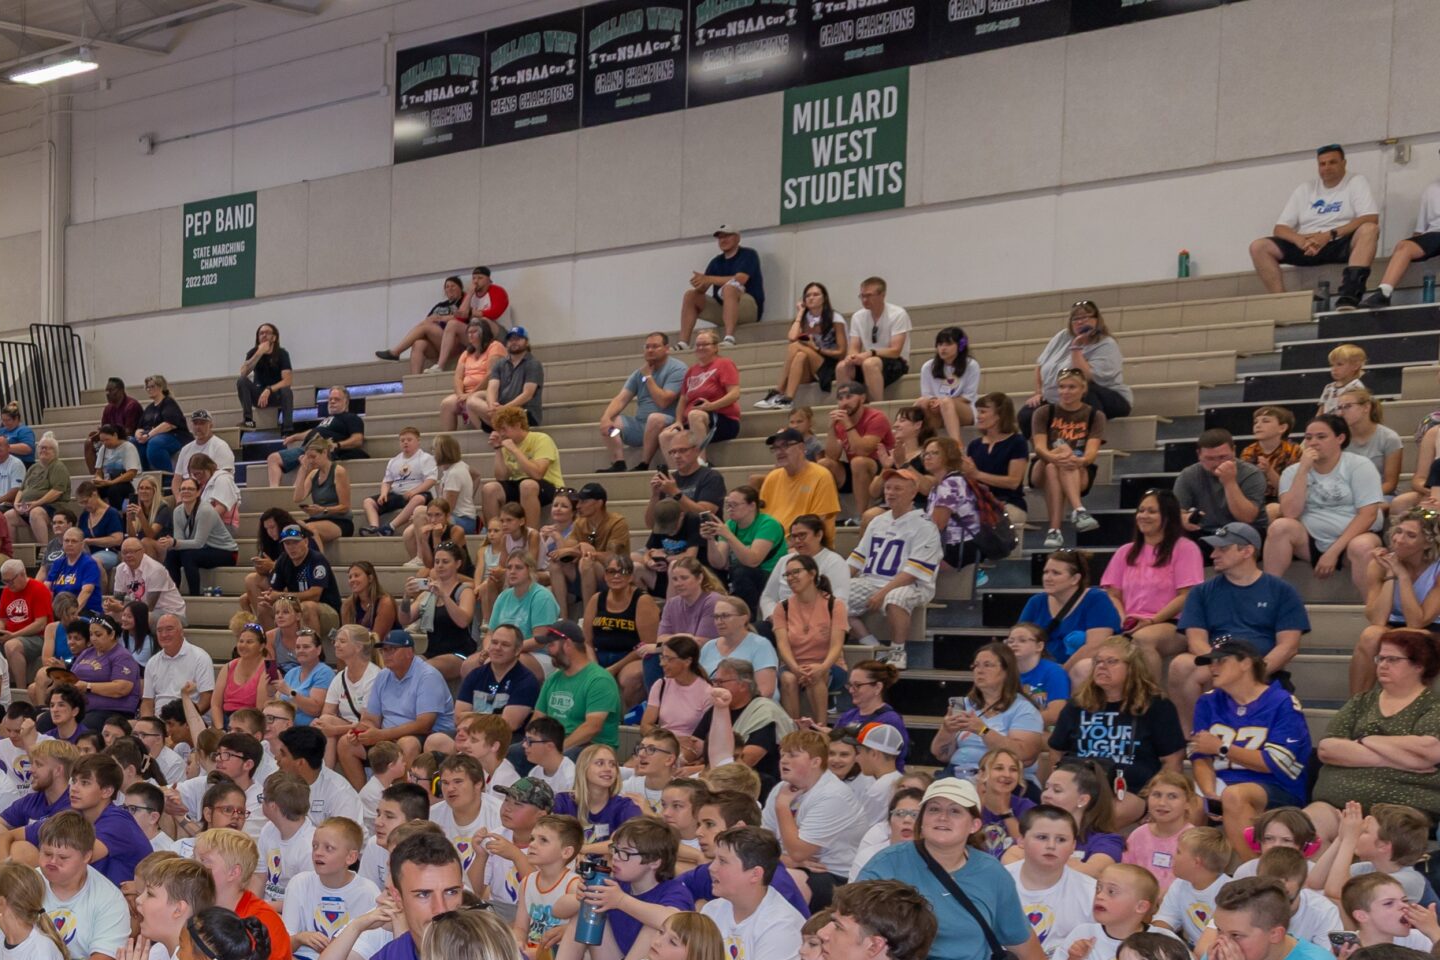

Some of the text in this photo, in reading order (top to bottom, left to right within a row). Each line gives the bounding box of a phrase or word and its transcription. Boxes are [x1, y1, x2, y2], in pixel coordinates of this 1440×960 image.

[589, 6, 683, 52] MILLARD WEST
[726, 15, 766, 37] NSAA
[819, 6, 915, 47] GRAND CHAMPIONS
[490, 30, 578, 75] MILLARD WEST
[617, 41, 653, 62] NSAA
[400, 53, 481, 95] MILLARD WEST
[516, 65, 549, 85] NSAA
[595, 59, 674, 95] GRAND CHAMPIONS
[424, 84, 454, 103] NSAA
[490, 84, 574, 116] MENS CHAMPIONS
[431, 102, 473, 128] CHAMPIONS
[792, 85, 898, 135] MILLARD
[811, 127, 878, 169] WEST
[784, 160, 903, 210] STUDENTS
[185, 203, 255, 238] PEP BAND
[193, 240, 245, 259] STATE MARCHING
[200, 254, 237, 270] CHAMPIONS
[185, 273, 218, 288] 2022 2023
[863, 537, 905, 577] 50
[1080, 725, 1132, 740] YOUR
[1081, 710, 1119, 726] LET
[1077, 739, 1141, 755] LIGHT
